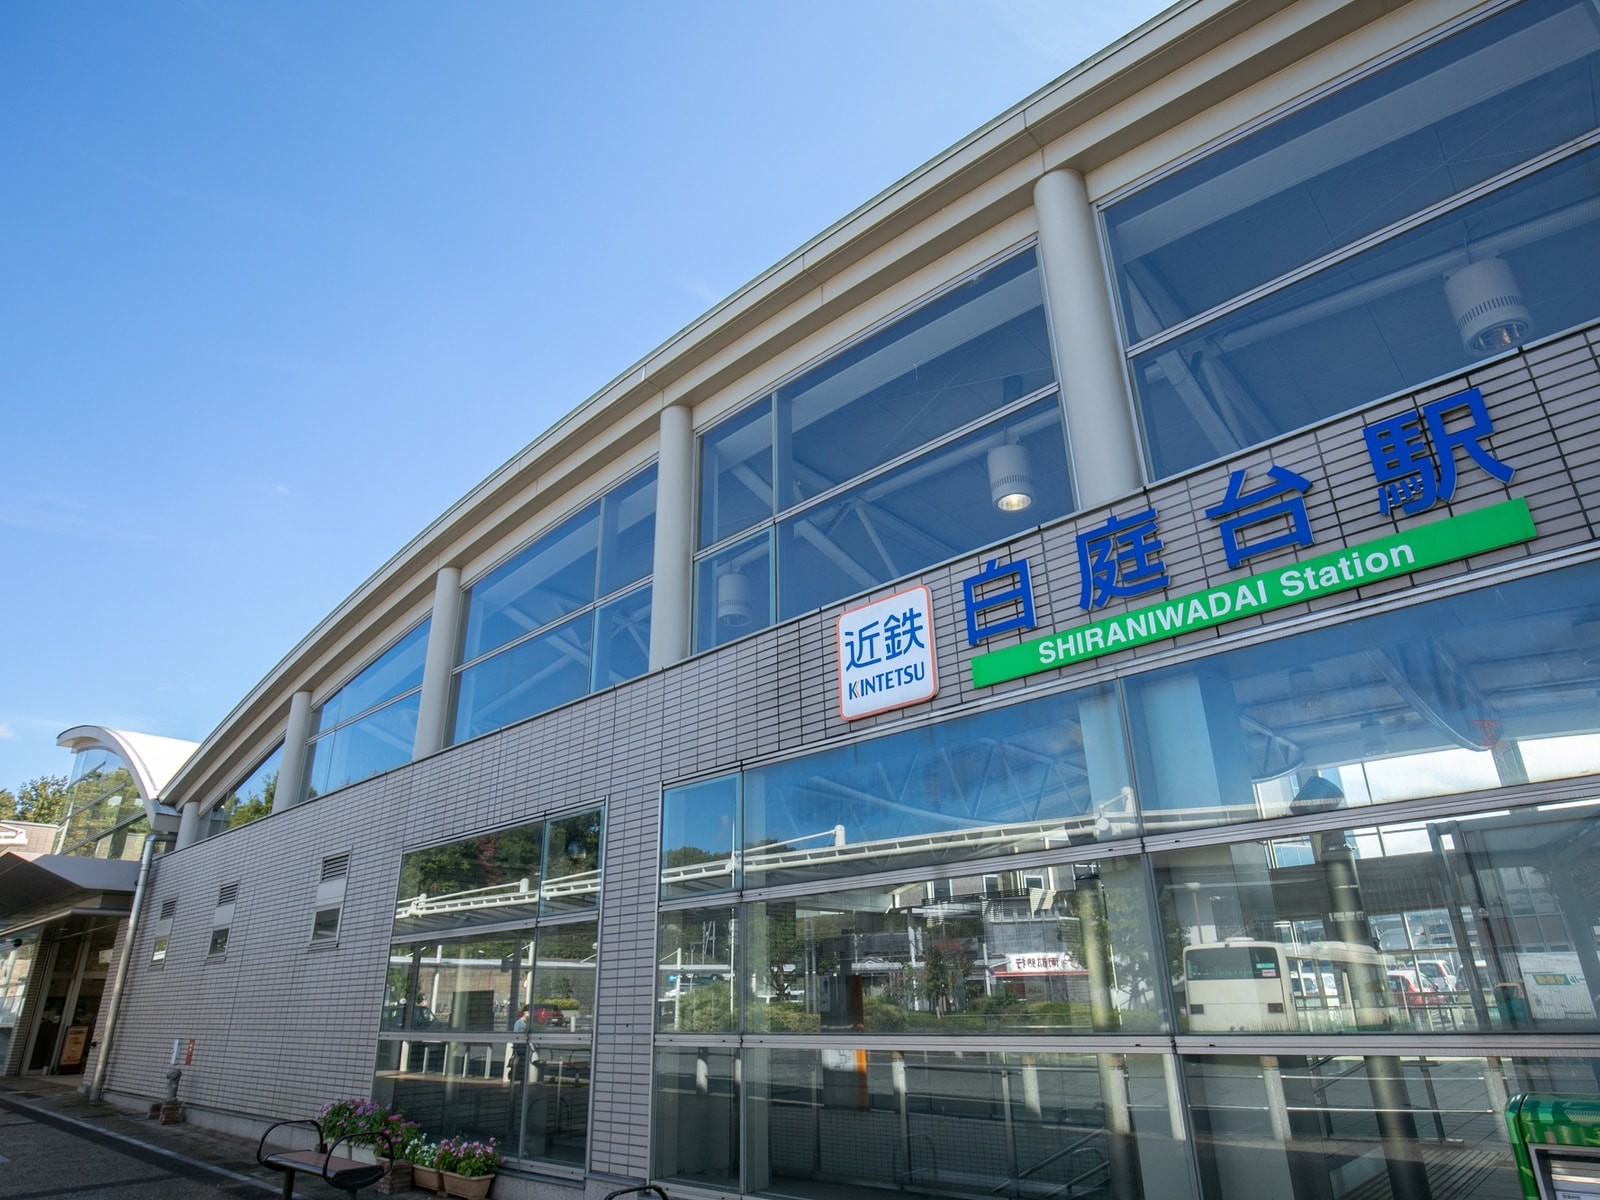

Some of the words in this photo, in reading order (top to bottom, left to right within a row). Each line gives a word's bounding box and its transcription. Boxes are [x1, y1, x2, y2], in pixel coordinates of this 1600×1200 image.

[963, 387, 1515, 646] 白庭台駅
[845, 607, 925, 672] 近鉄
[1039, 580, 1268, 664] SHIRANIWADAI
[1280, 544, 1415, 597] Station
[848, 661, 925, 700] KINTETSU
